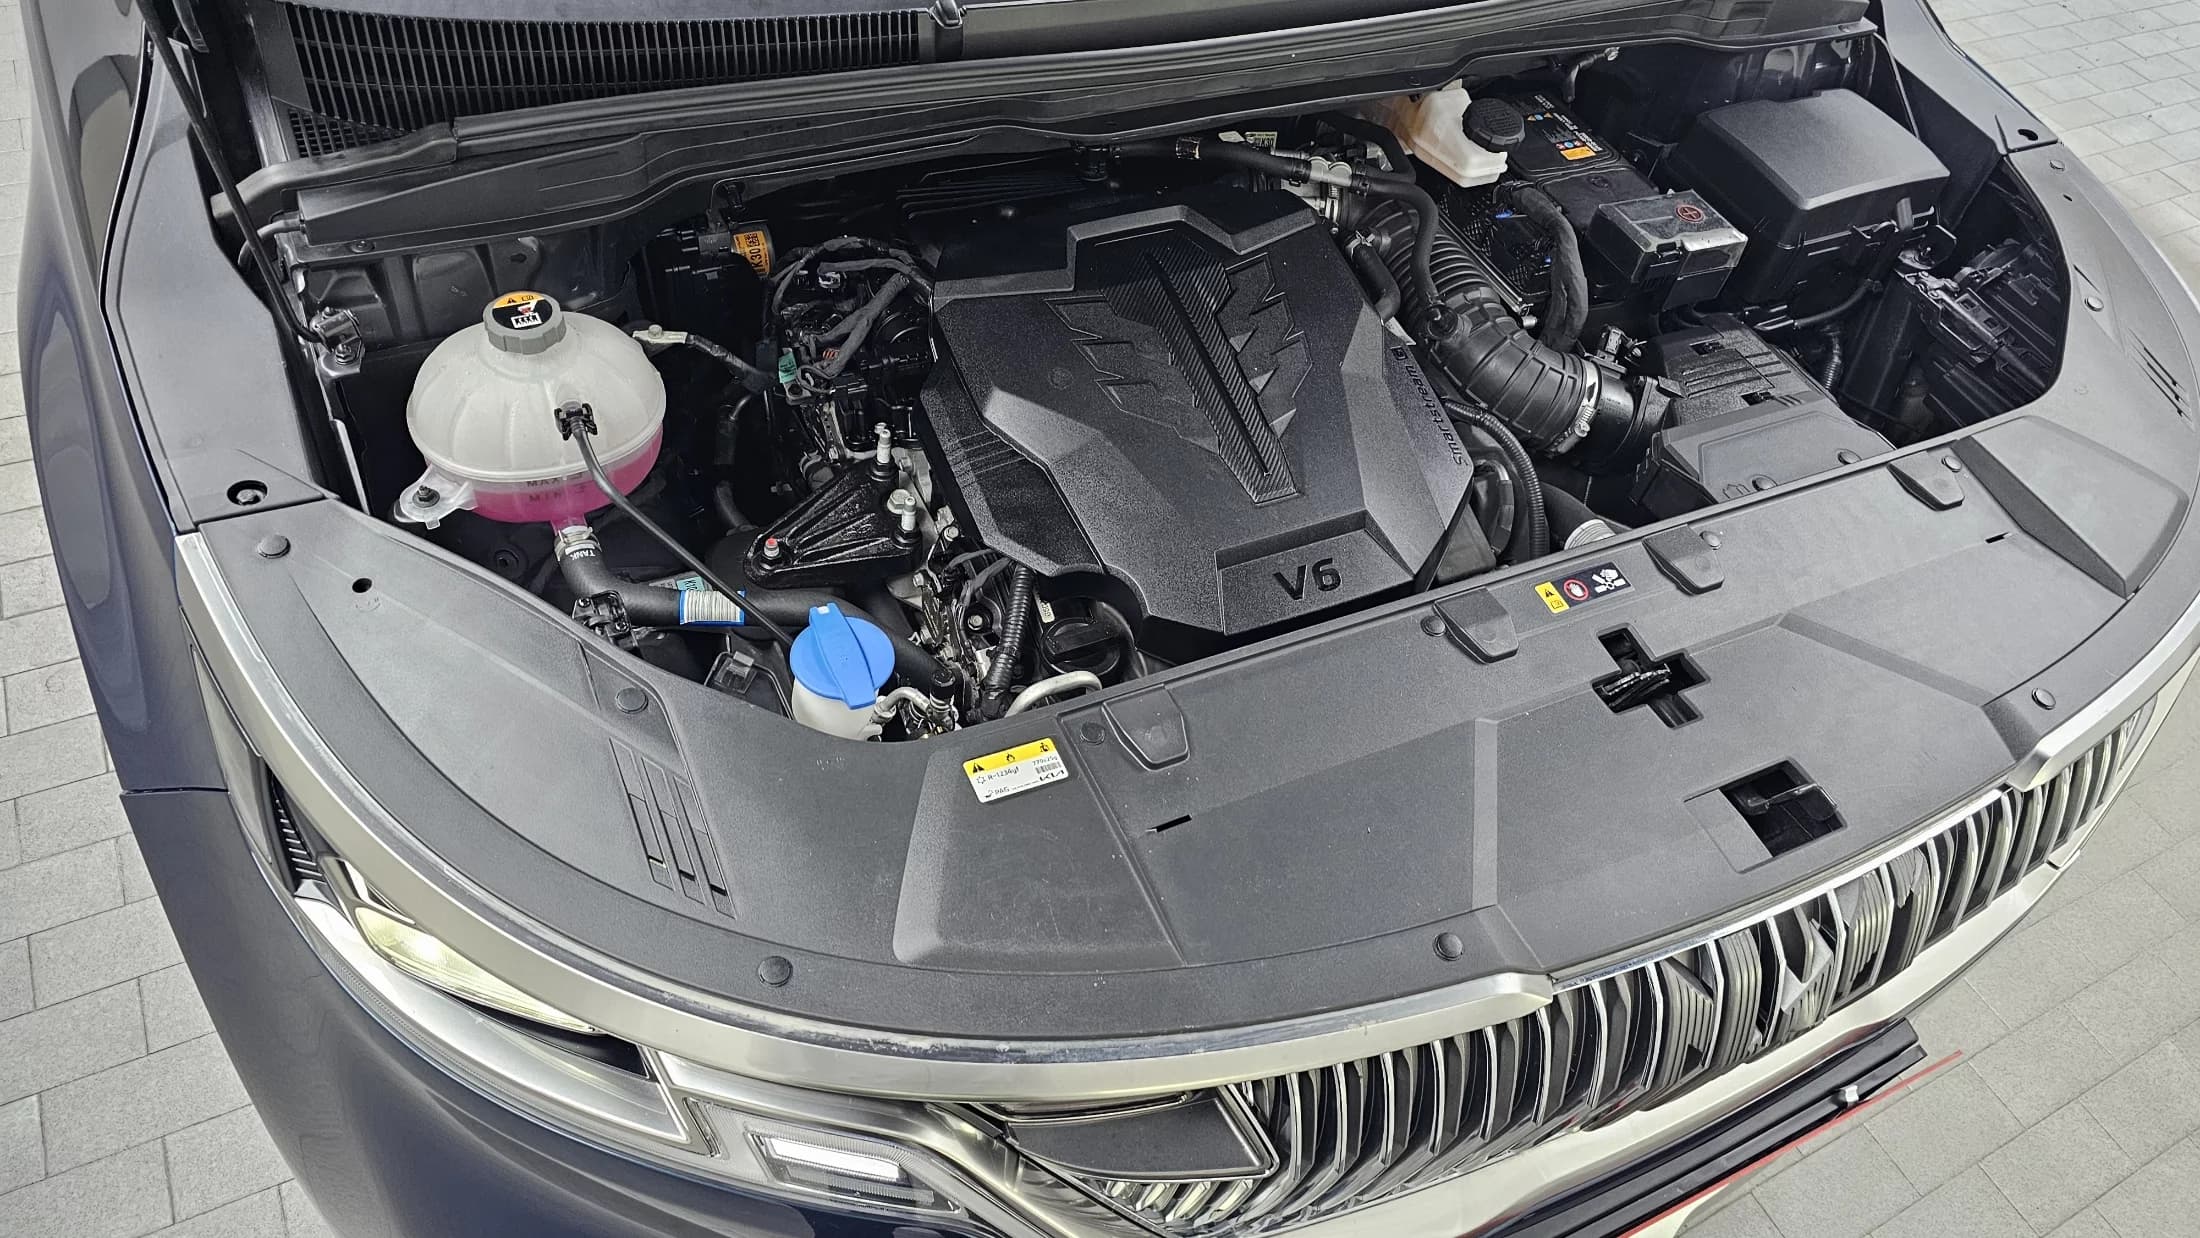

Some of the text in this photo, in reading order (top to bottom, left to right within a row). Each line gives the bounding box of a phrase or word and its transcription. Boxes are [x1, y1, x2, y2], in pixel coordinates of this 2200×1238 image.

[1405, 365, 1469, 466] Smartstream
[570, 549, 596, 561] TANK
[1272, 557, 1342, 601] V6
[987, 766, 1020, 780] R-1234yf
